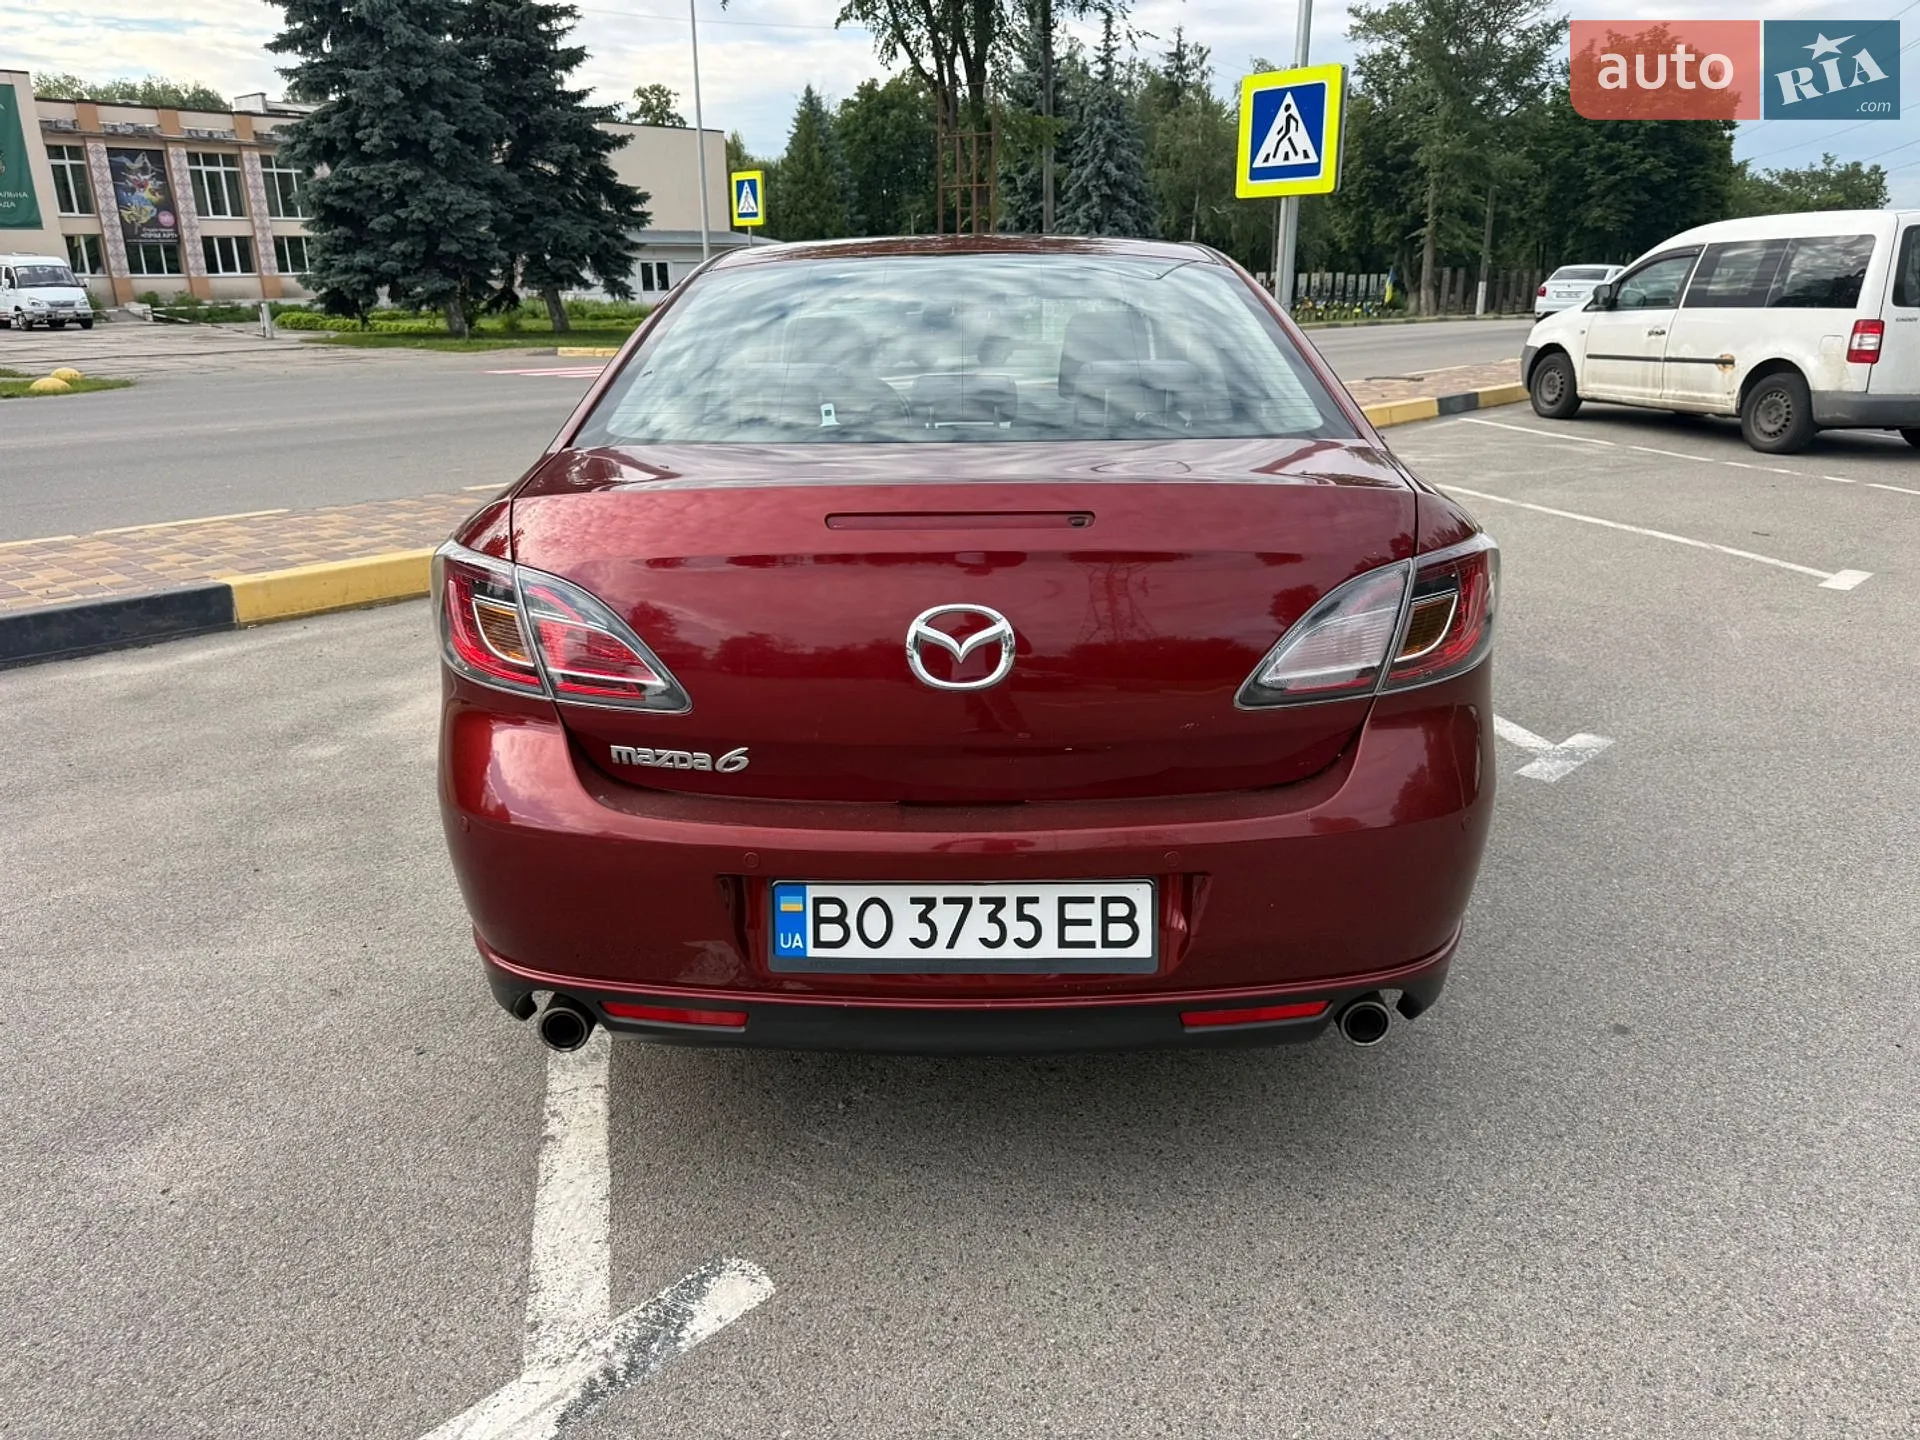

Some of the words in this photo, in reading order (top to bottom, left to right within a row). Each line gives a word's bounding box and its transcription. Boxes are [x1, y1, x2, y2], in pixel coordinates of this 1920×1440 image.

[811, 896, 893, 949] BO
[908, 896, 1043, 949] 3735
[1057, 896, 1140, 949] EB
[780, 933, 804, 949] UA
